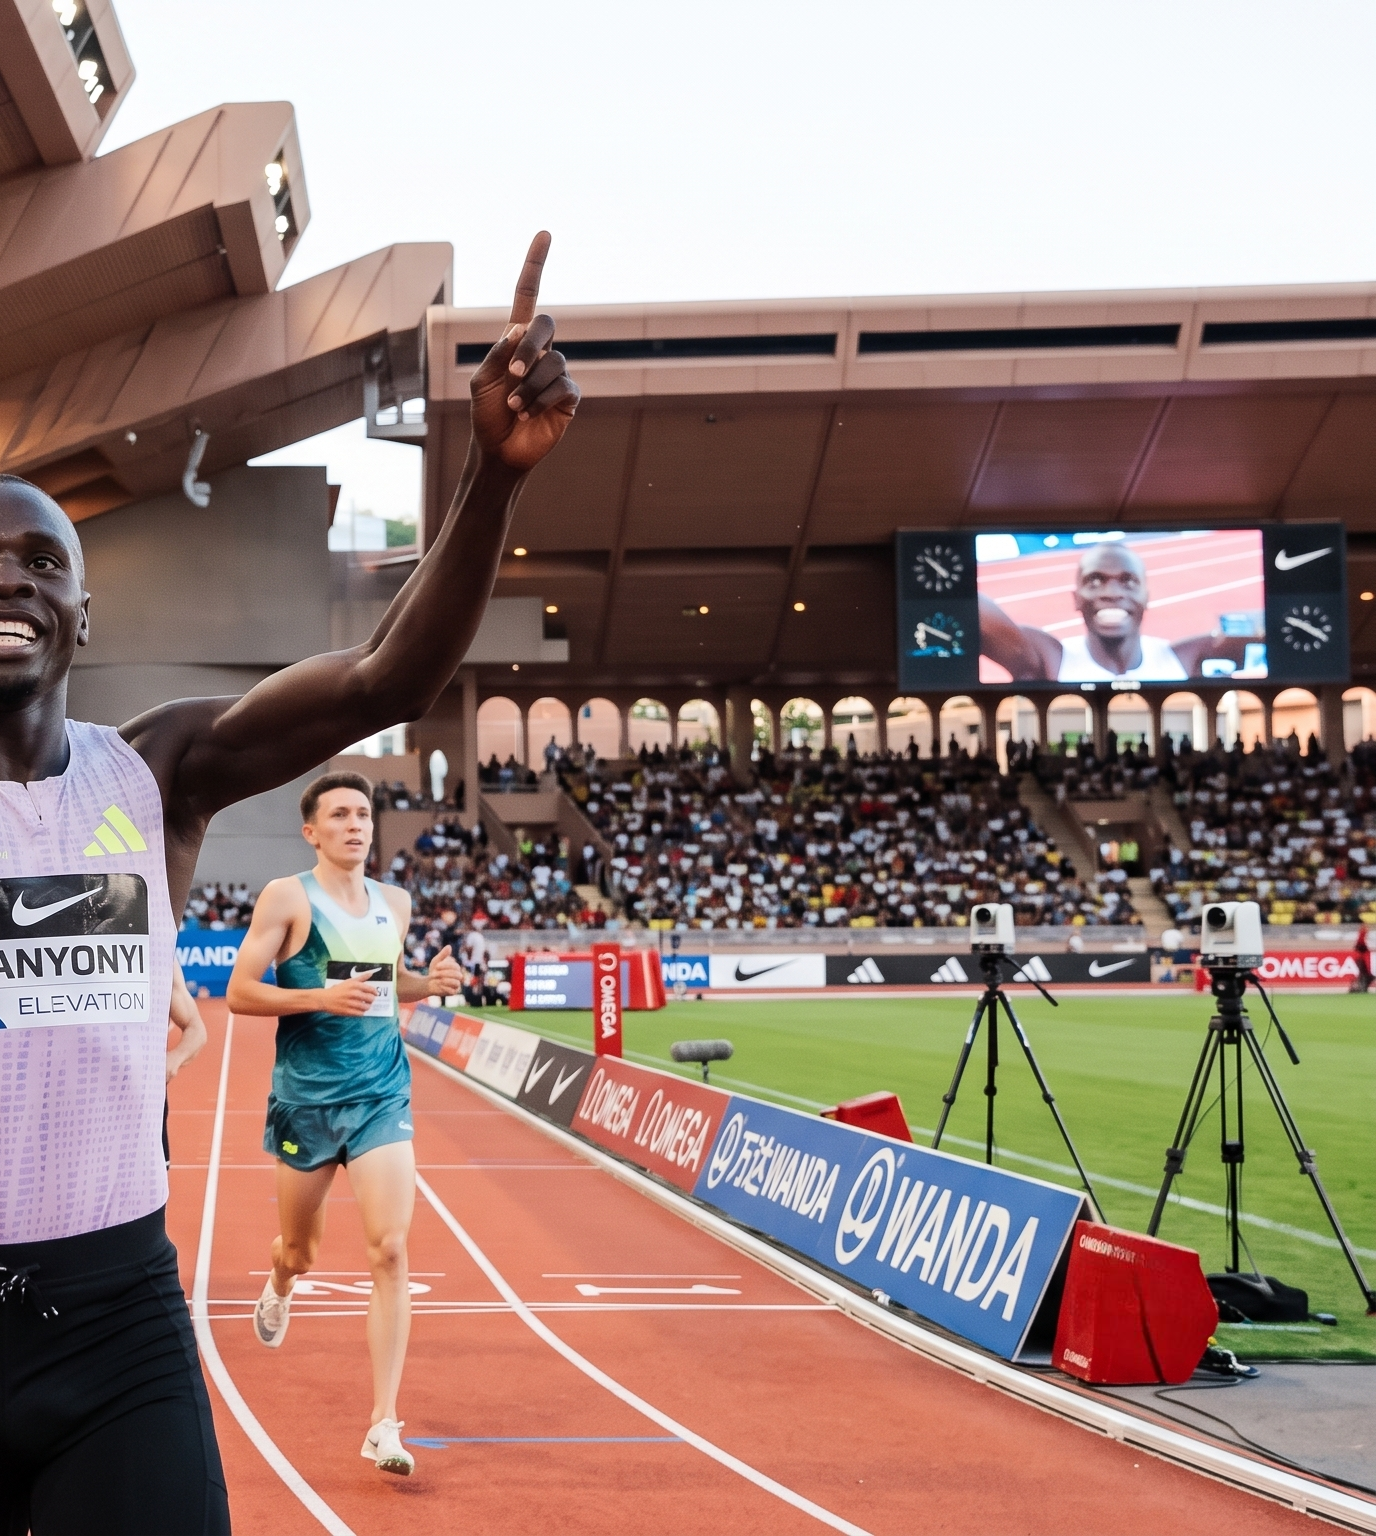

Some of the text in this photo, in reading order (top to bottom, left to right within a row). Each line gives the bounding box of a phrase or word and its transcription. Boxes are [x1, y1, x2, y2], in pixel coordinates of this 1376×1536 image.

[176, 945, 239, 967] WAND
[1257, 955, 1360, 979] OMEGA
[18, 992, 145, 1016] ELEVATION
[599, 974, 617, 1039] OMEGA
[591, 1078, 712, 1173] OMEGA OMEGA
[876, 1175, 1040, 1322] WANDA
[575, 1283, 743, 1297] 1
